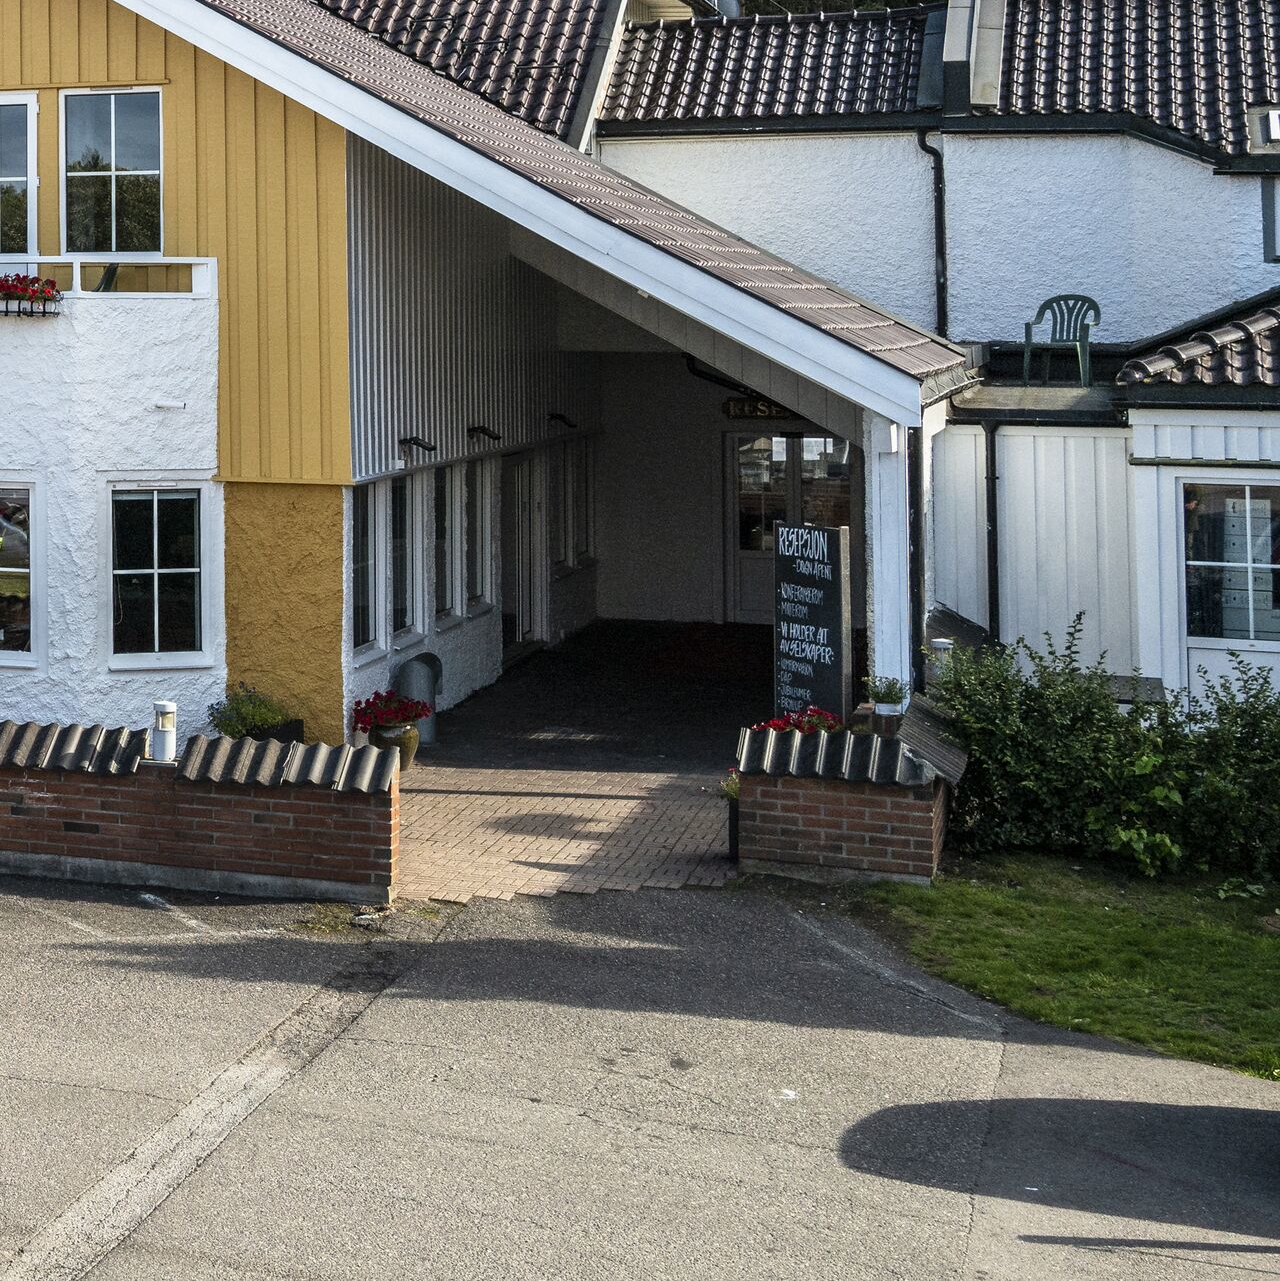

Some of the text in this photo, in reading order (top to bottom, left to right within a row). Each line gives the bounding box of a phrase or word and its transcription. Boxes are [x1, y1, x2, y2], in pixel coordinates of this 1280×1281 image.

[789, 622, 816, 642] HOLDER
[816, 627, 829, 645] ALT
[780, 638, 835, 665] AV SELSKAPER:
